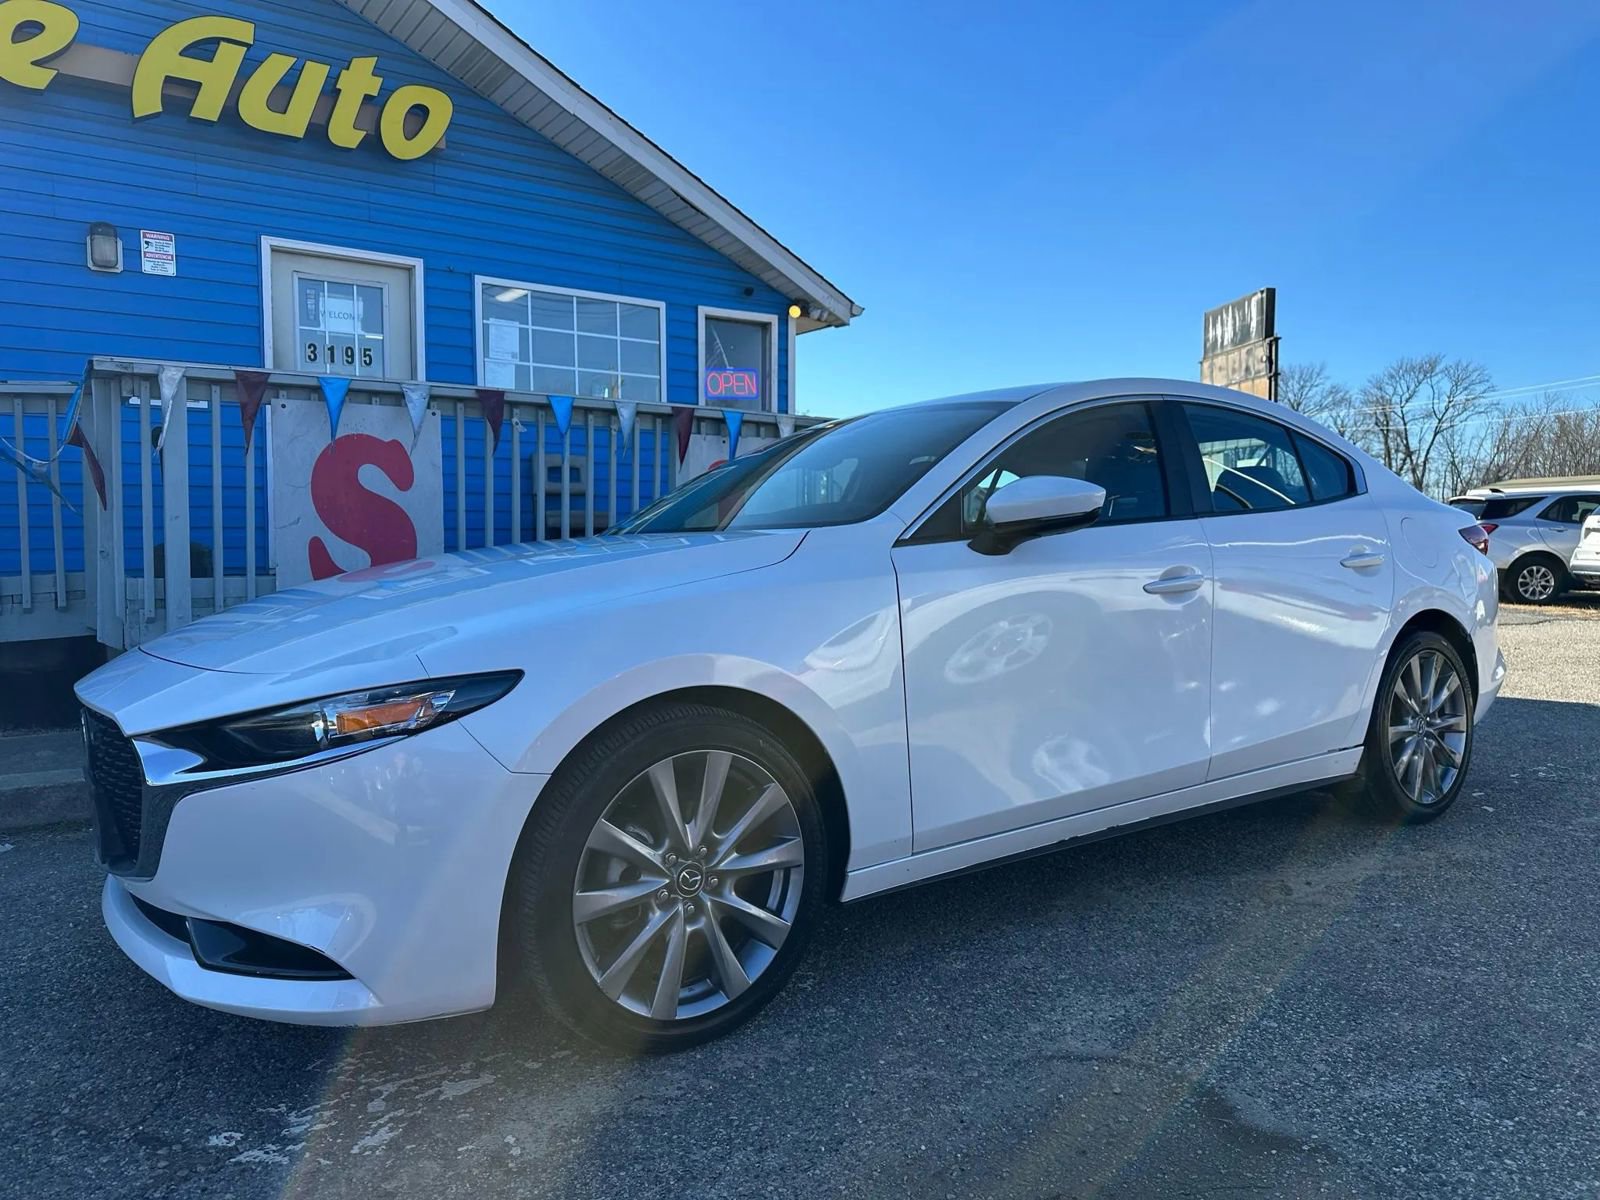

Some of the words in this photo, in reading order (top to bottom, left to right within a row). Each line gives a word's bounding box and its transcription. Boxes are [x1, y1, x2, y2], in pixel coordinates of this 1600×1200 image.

[131, 15, 454, 161] Auto
[319, 310, 363, 321] WELCOM
[307, 343, 373, 367] 3195
[706, 371, 758, 396] OPEN
